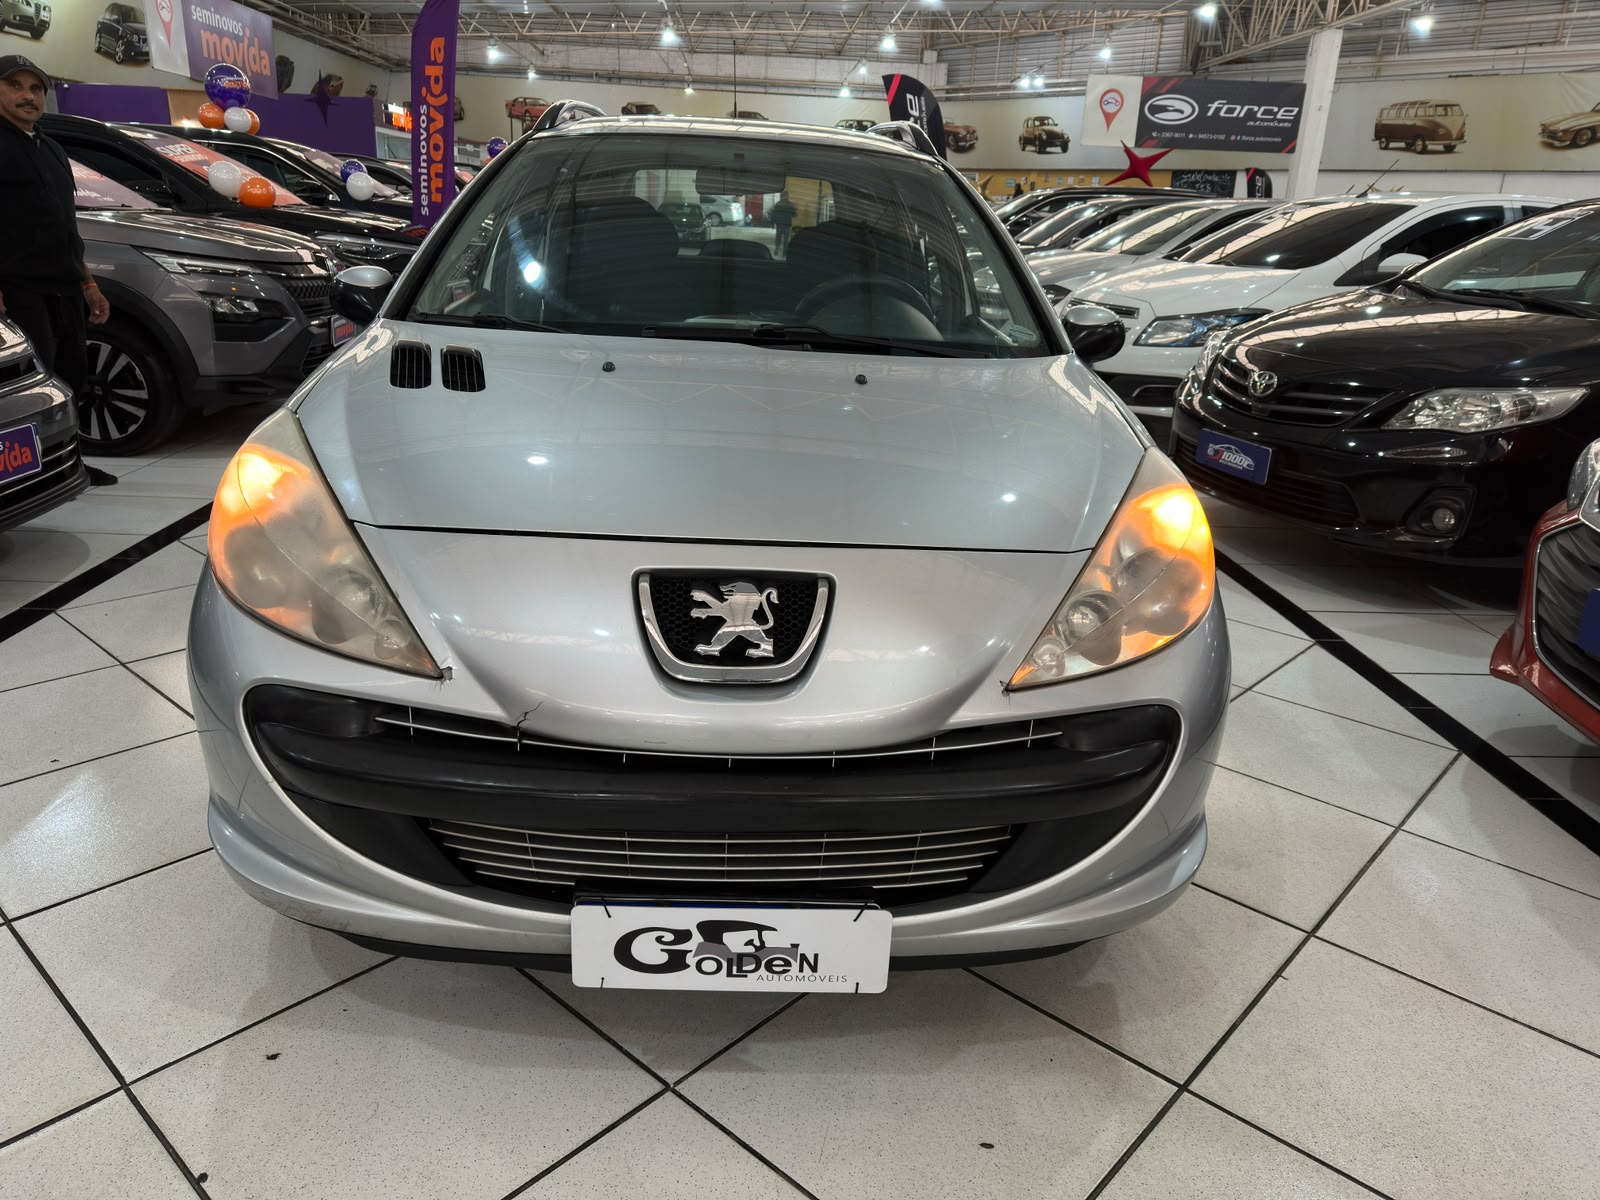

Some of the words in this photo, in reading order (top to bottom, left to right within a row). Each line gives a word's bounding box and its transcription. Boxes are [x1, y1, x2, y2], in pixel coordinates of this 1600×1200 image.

[191, 5, 243, 36] seminovos
[201, 27, 271, 77] movida
[421, 36, 448, 203] movida
[1207, 100, 1299, 120] force
[418, 104, 429, 217] seminovos
[756, 973, 848, 984] AUTOMÓVEIS
